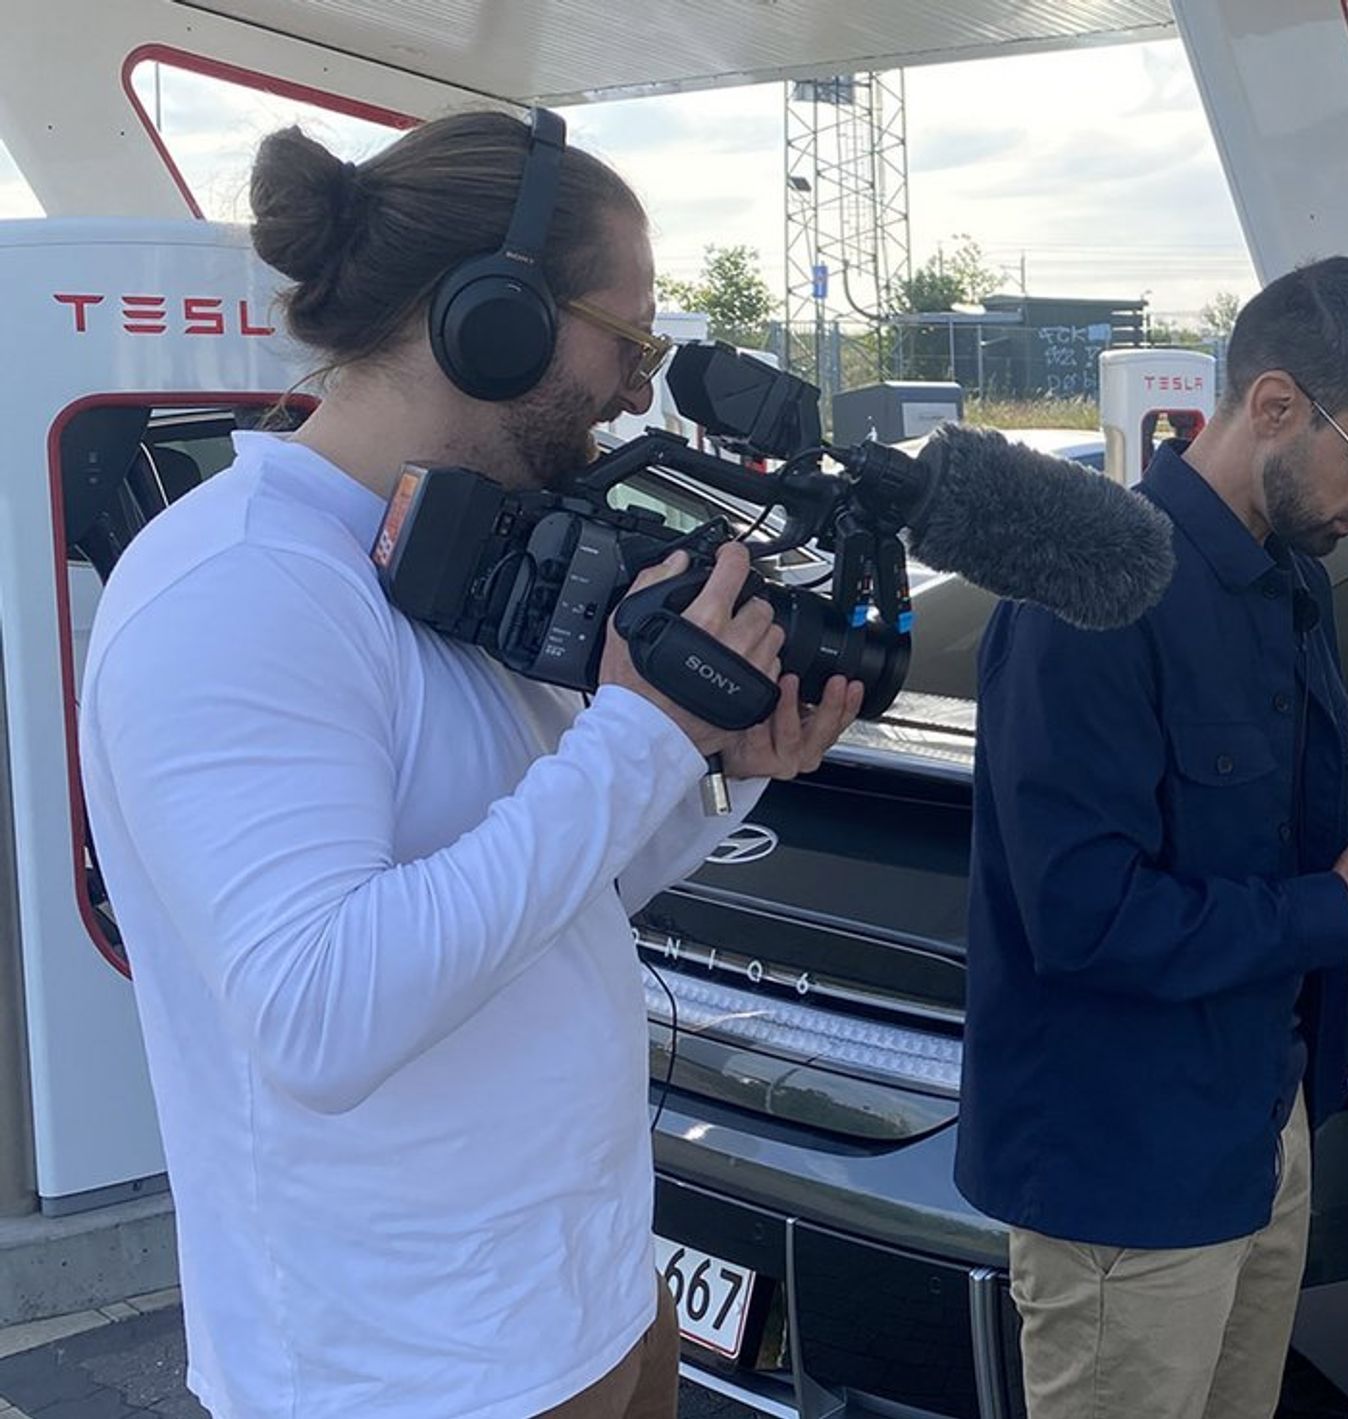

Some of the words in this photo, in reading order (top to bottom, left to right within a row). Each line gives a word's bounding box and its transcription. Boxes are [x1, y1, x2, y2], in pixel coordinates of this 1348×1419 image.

[53, 294, 276, 336] TESL
[1144, 376, 1203, 390] TESLA
[684, 655, 741, 695] SONY
[664, 1247, 743, 1330] 667
